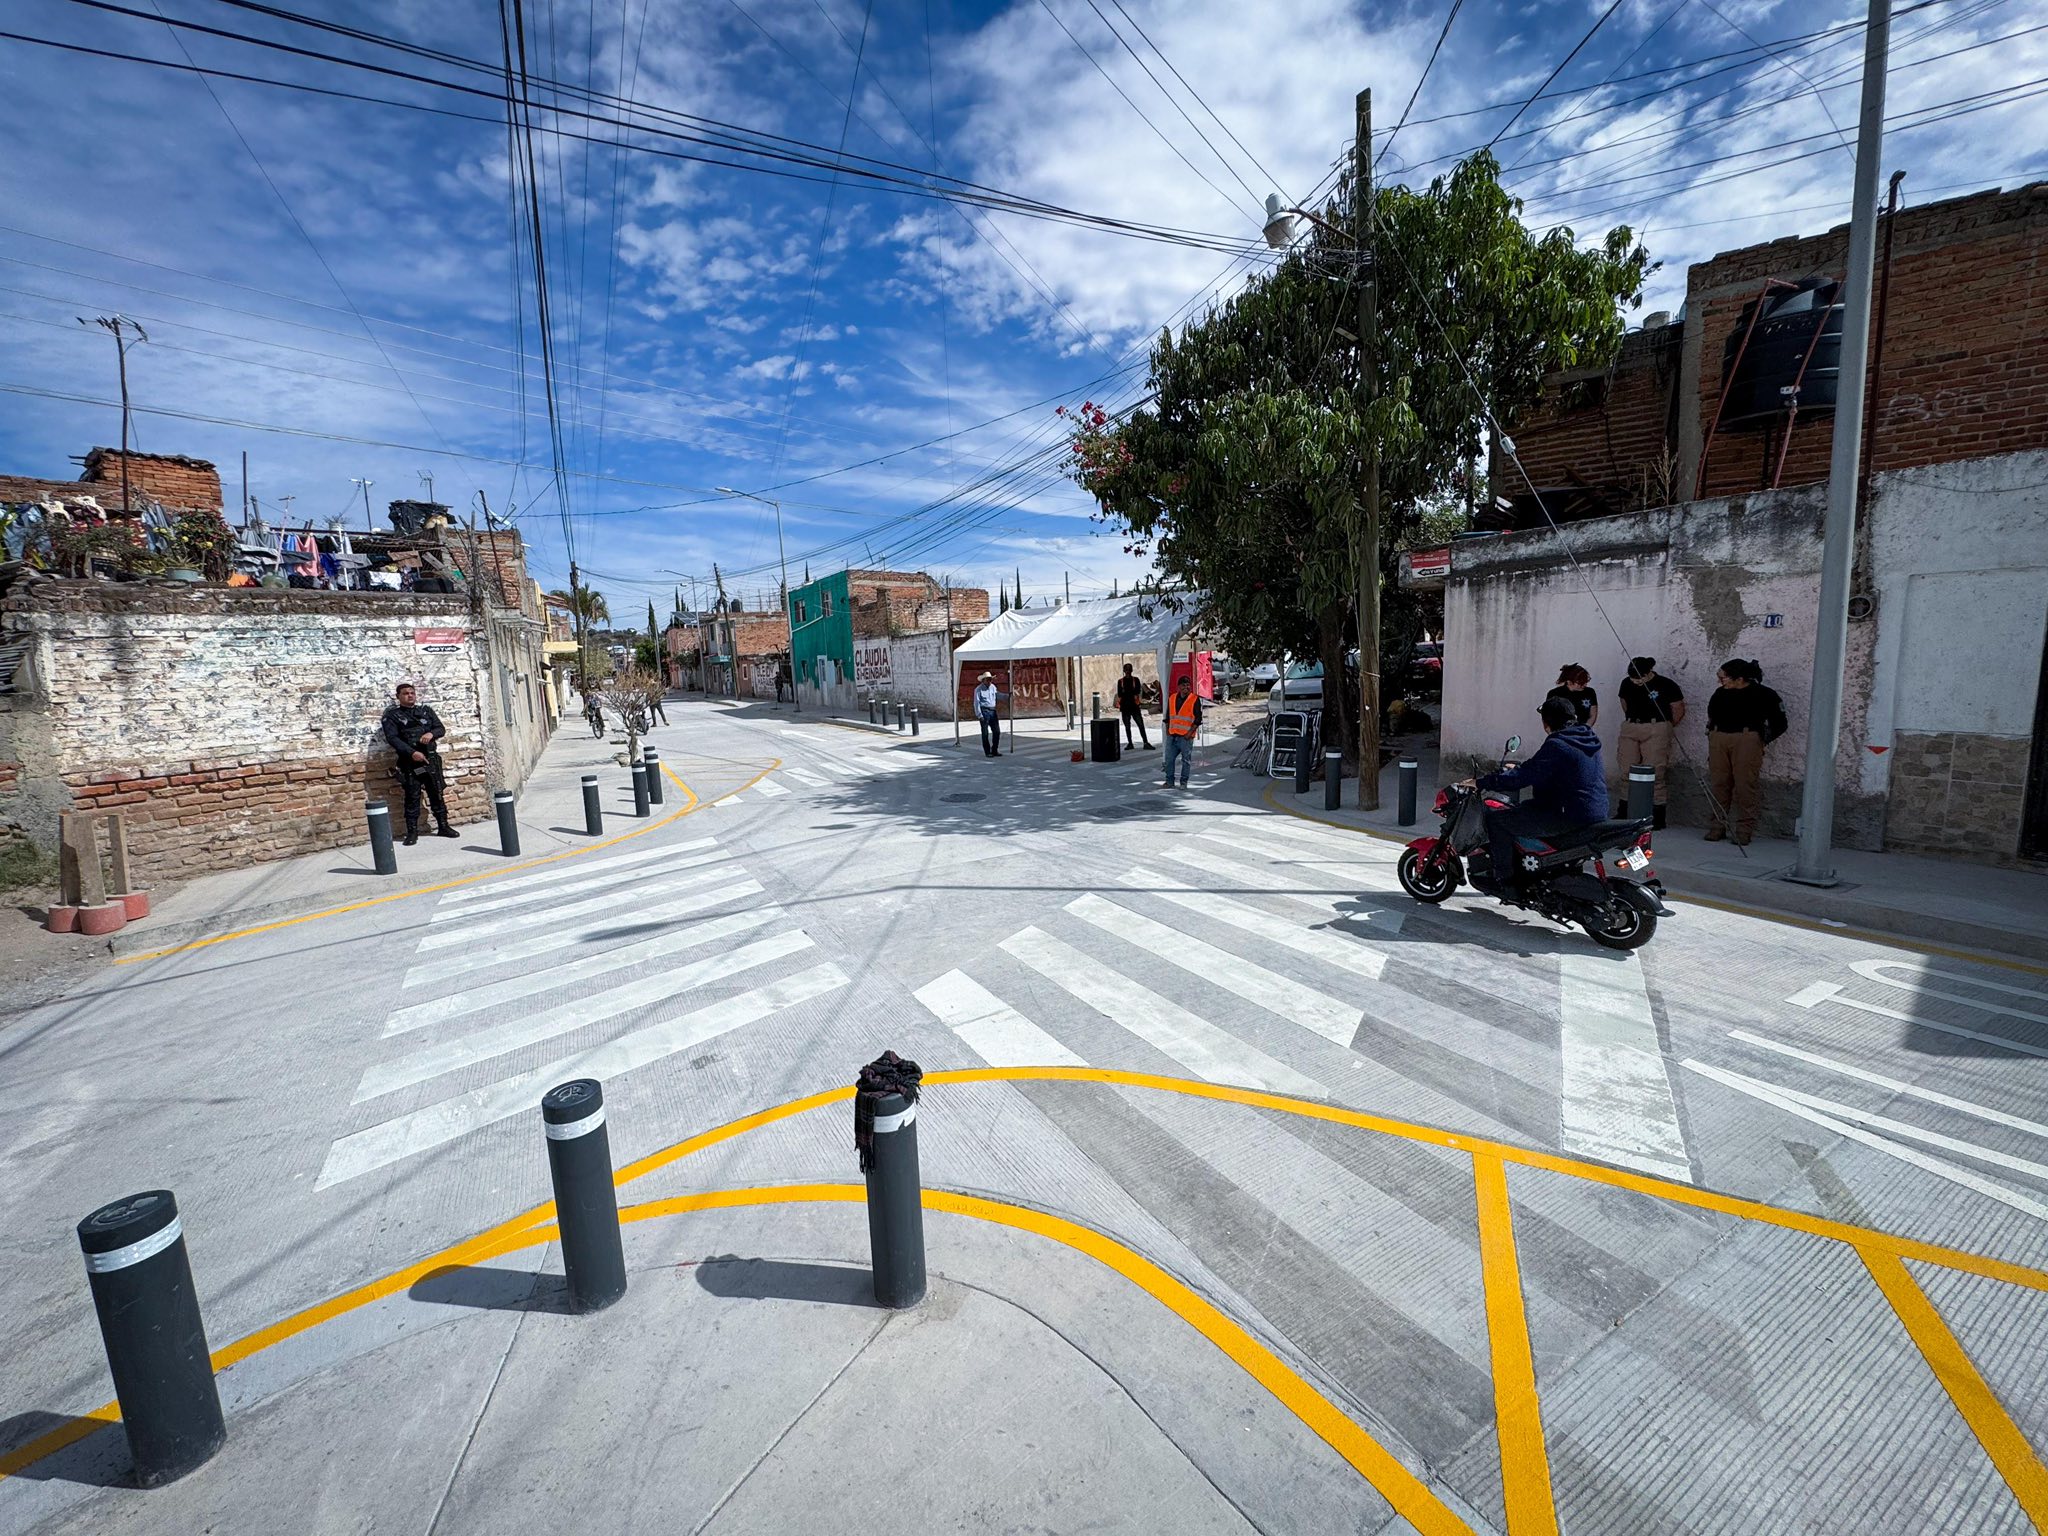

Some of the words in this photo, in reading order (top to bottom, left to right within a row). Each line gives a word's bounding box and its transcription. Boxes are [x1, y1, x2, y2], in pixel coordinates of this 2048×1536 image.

[1766, 613, 1782, 626] 10
[855, 648, 889, 667] CLAUDIA
[856, 665, 891, 681] SHEINBAUM
